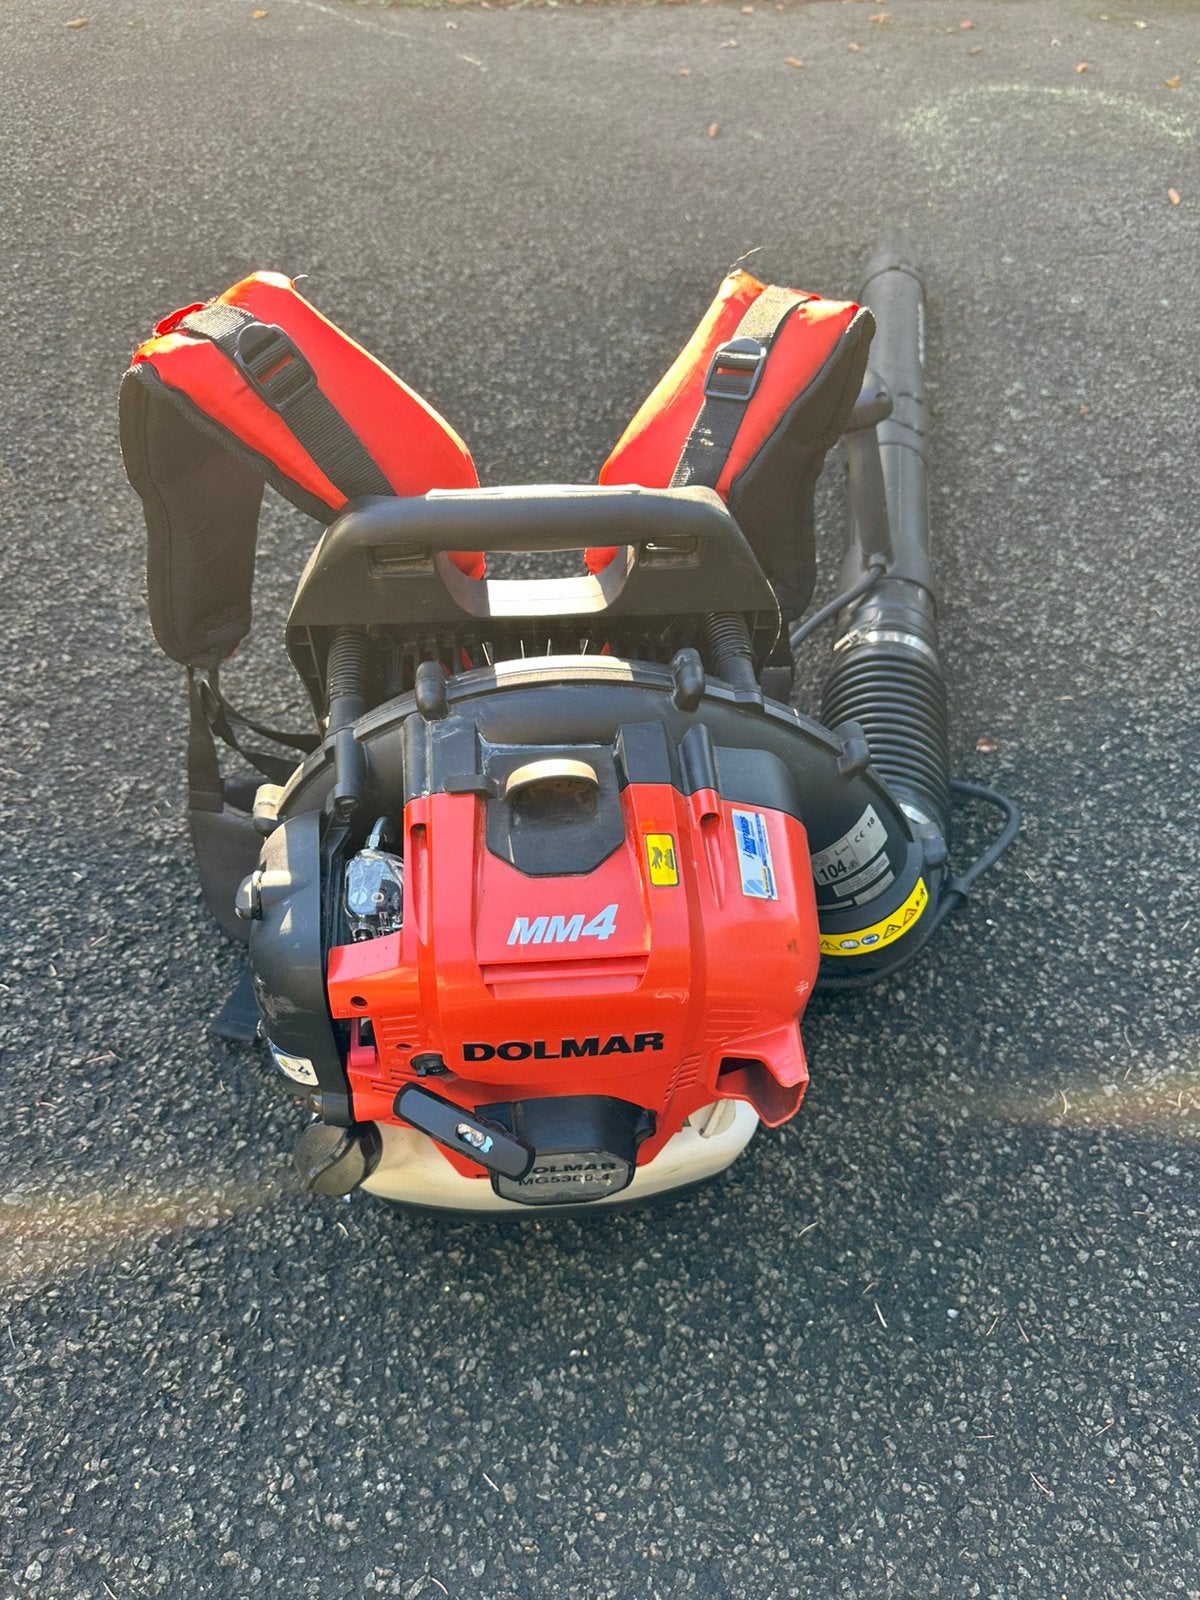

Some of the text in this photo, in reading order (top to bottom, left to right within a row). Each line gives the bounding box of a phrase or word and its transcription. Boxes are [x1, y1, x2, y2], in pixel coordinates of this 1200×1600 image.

[819, 860, 847, 881] 104
[507, 904, 619, 945] MM4
[462, 1032, 665, 1062] DOLMAR
[531, 1162, 617, 1174] OLMAR
